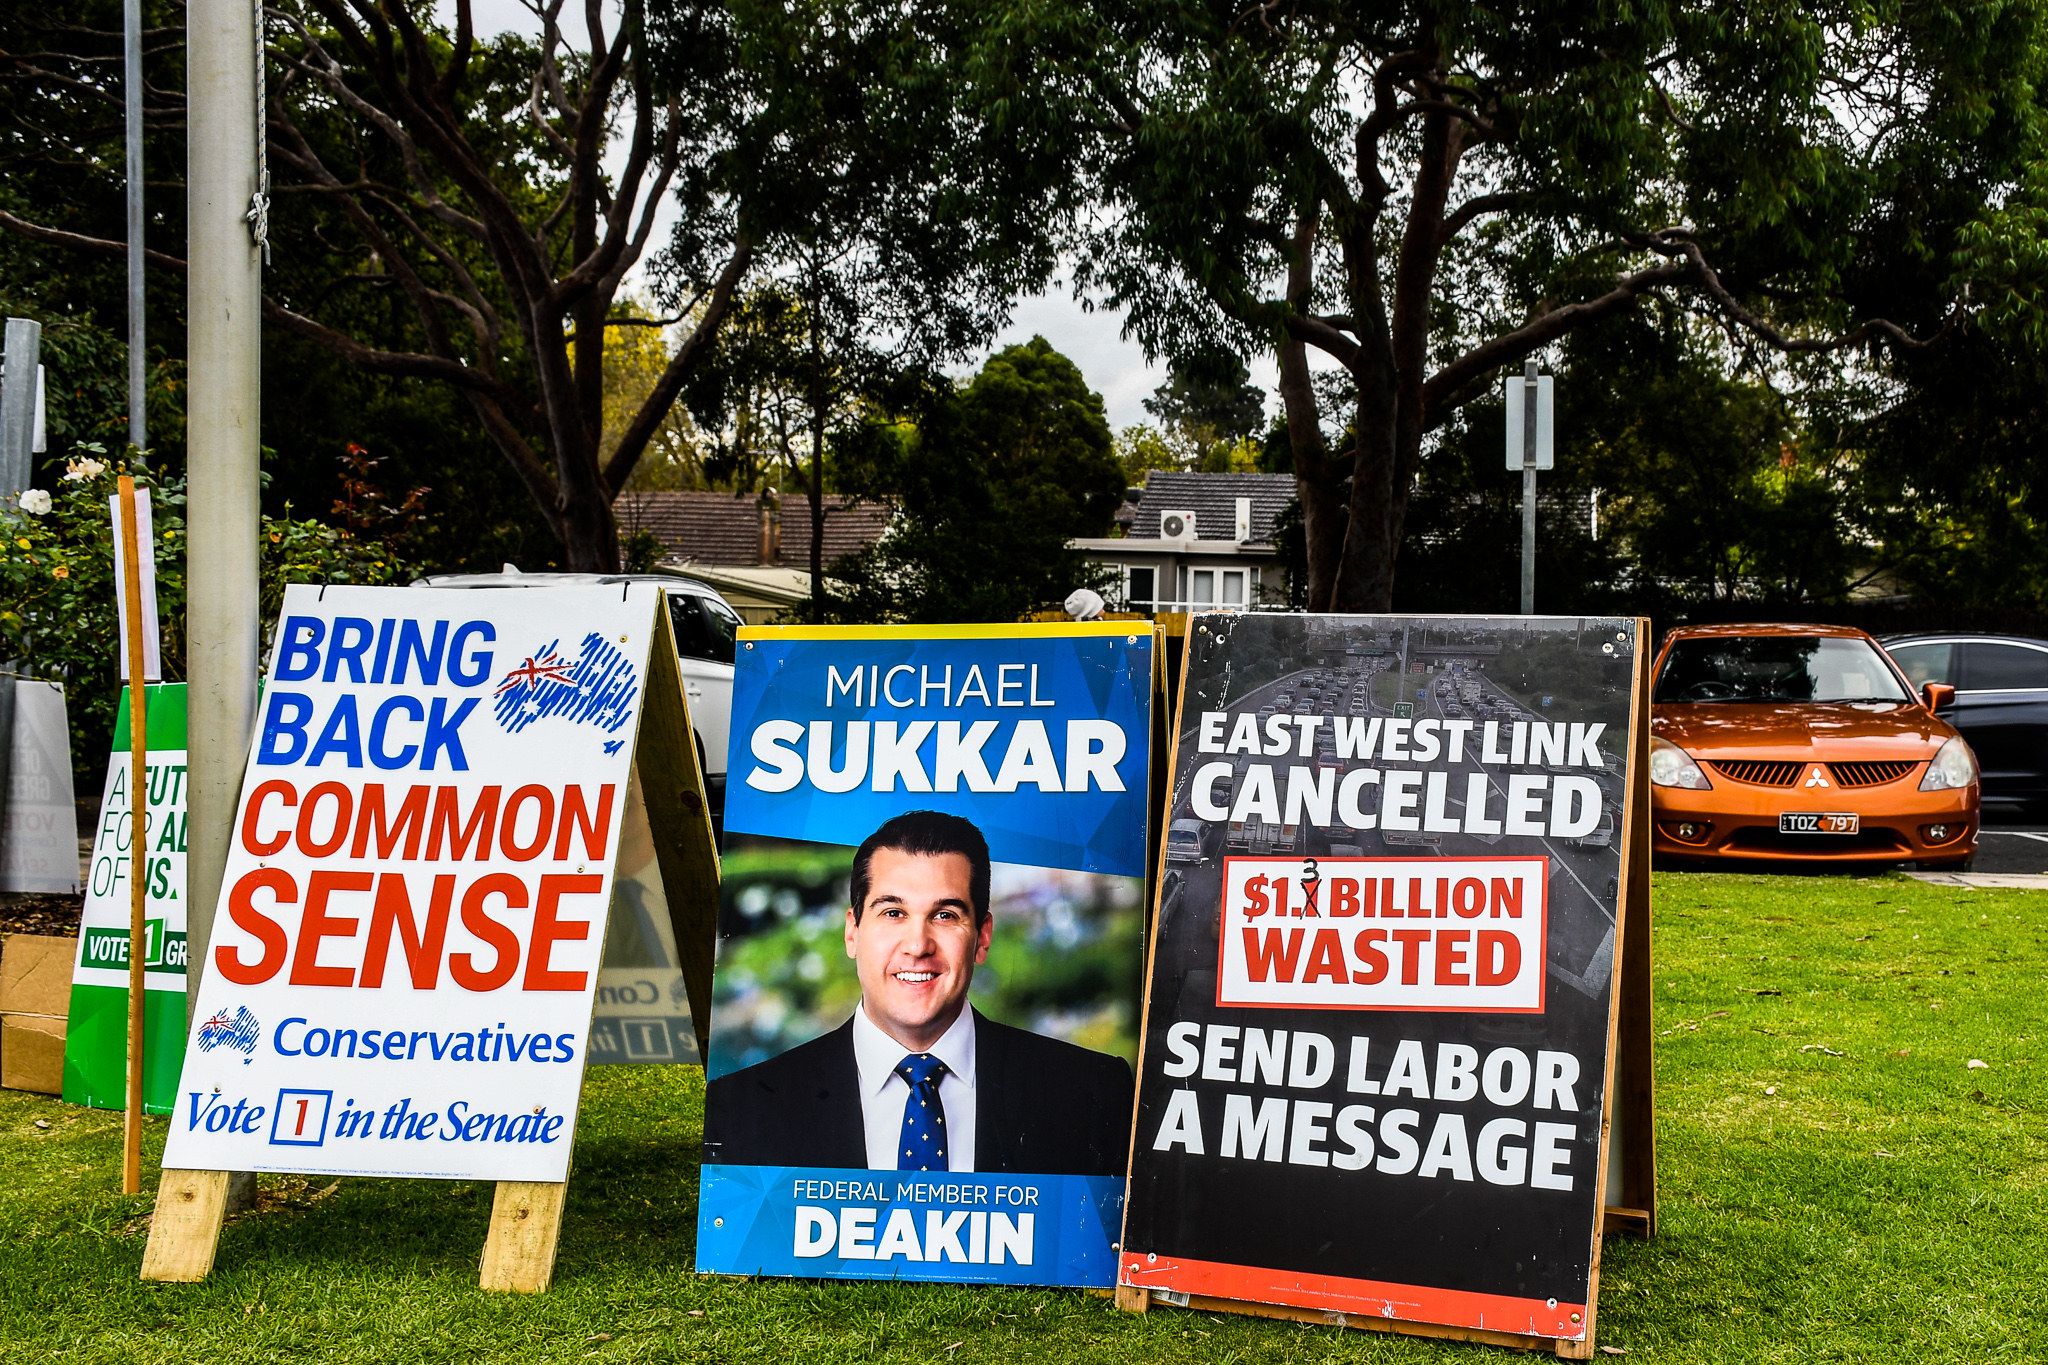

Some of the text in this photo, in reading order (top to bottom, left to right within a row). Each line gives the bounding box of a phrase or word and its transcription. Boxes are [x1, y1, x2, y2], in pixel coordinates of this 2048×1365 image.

[274, 615, 497, 688] BRING
[825, 663, 1056, 707] MICHAEL
[256, 692, 482, 771] BACK
[745, 719, 1128, 795] SUKKAR
[1198, 712, 1607, 768] EAST WEST LINK
[108, 766, 125, 806] A
[1191, 762, 1603, 838] CANCELLED
[156, 811, 187, 852] AL
[241, 779, 616, 862] COMMON
[1788, 815, 1857, 831] TOZ 797
[93, 856, 130, 898] OF
[1329, 877, 1523, 919] BILLION
[89, 935, 131, 962] VOTE
[165, 940, 187, 967] GR
[215, 867, 604, 992] SENSE
[1242, 927, 1523, 987] WASTED
[273, 1017, 575, 1063] Conservatives
[1163, 1021, 1580, 1112] SEND LABOR
[188, 1092, 564, 1144] Vote 1 in the Senate
[1152, 1089, 1578, 1192] A MESSAGE
[793, 1180, 1039, 1206] FEDERAL MEMBER FOR
[793, 1205, 1035, 1266] DEAKIN
